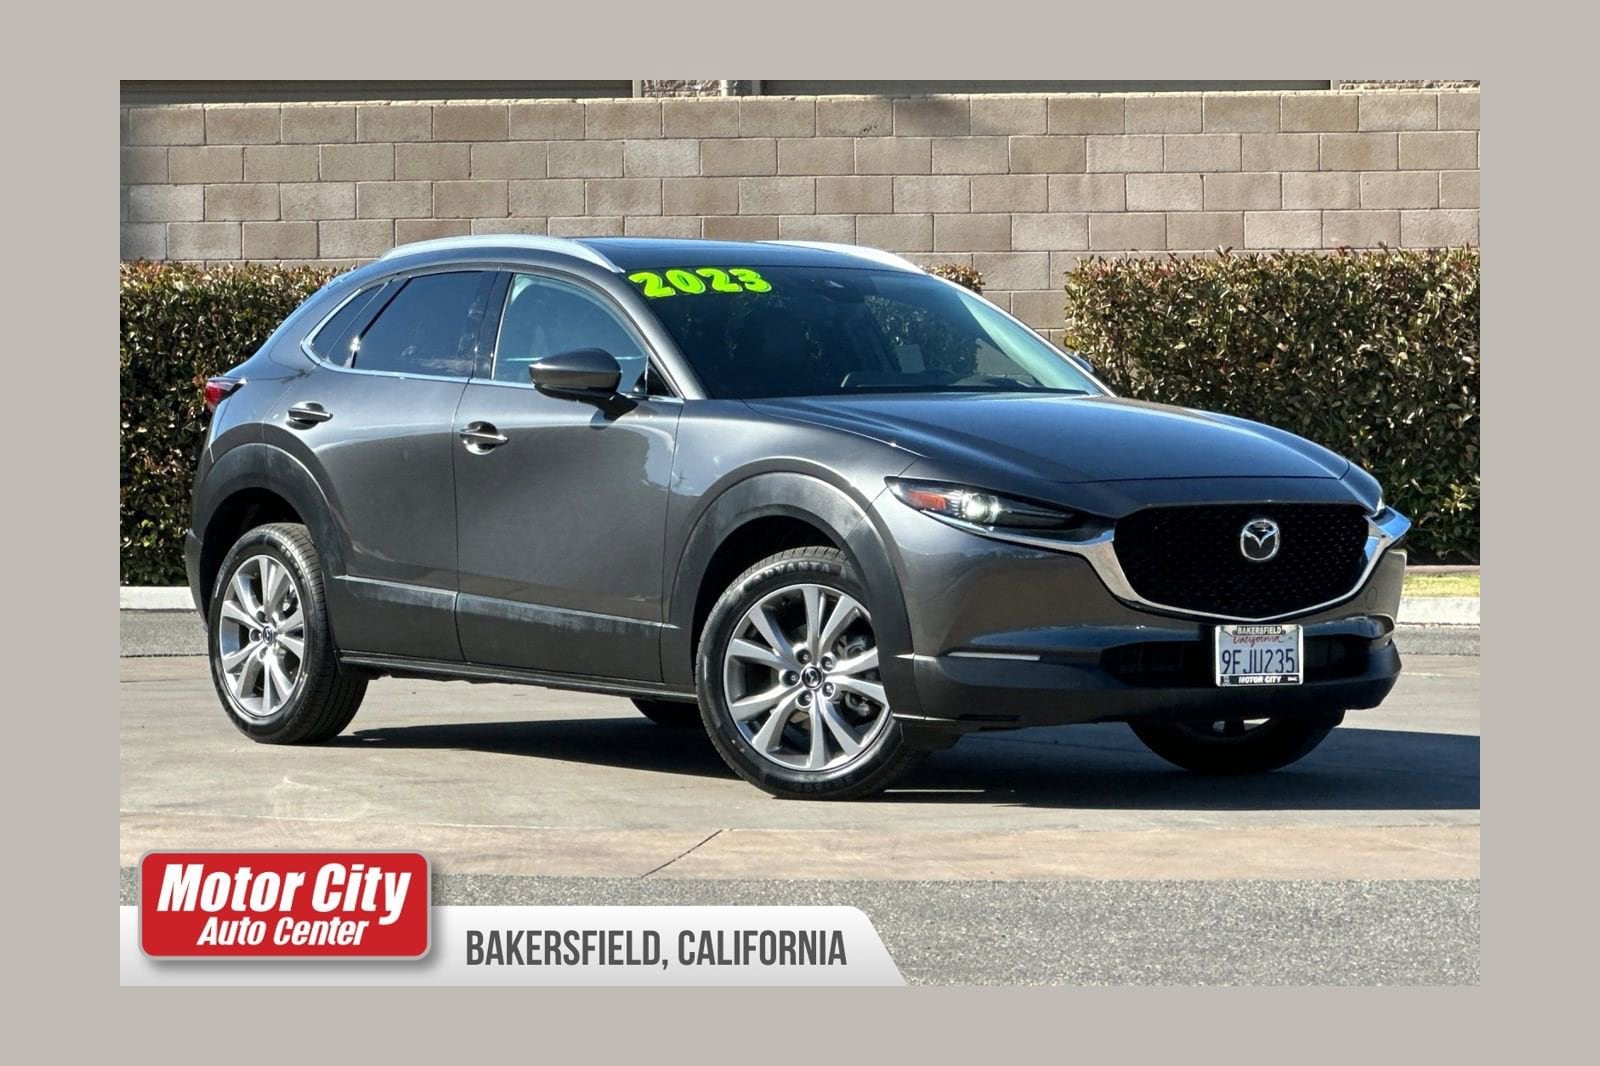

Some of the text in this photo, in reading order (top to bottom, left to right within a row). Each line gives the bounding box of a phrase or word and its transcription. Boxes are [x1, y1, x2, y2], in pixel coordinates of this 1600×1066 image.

[628, 267, 772, 298] 2023
[1237, 626, 1282, 634] BAKERSFIELD
[1238, 676, 1263, 684] MOTOR
[1264, 676, 1282, 684] CITY
